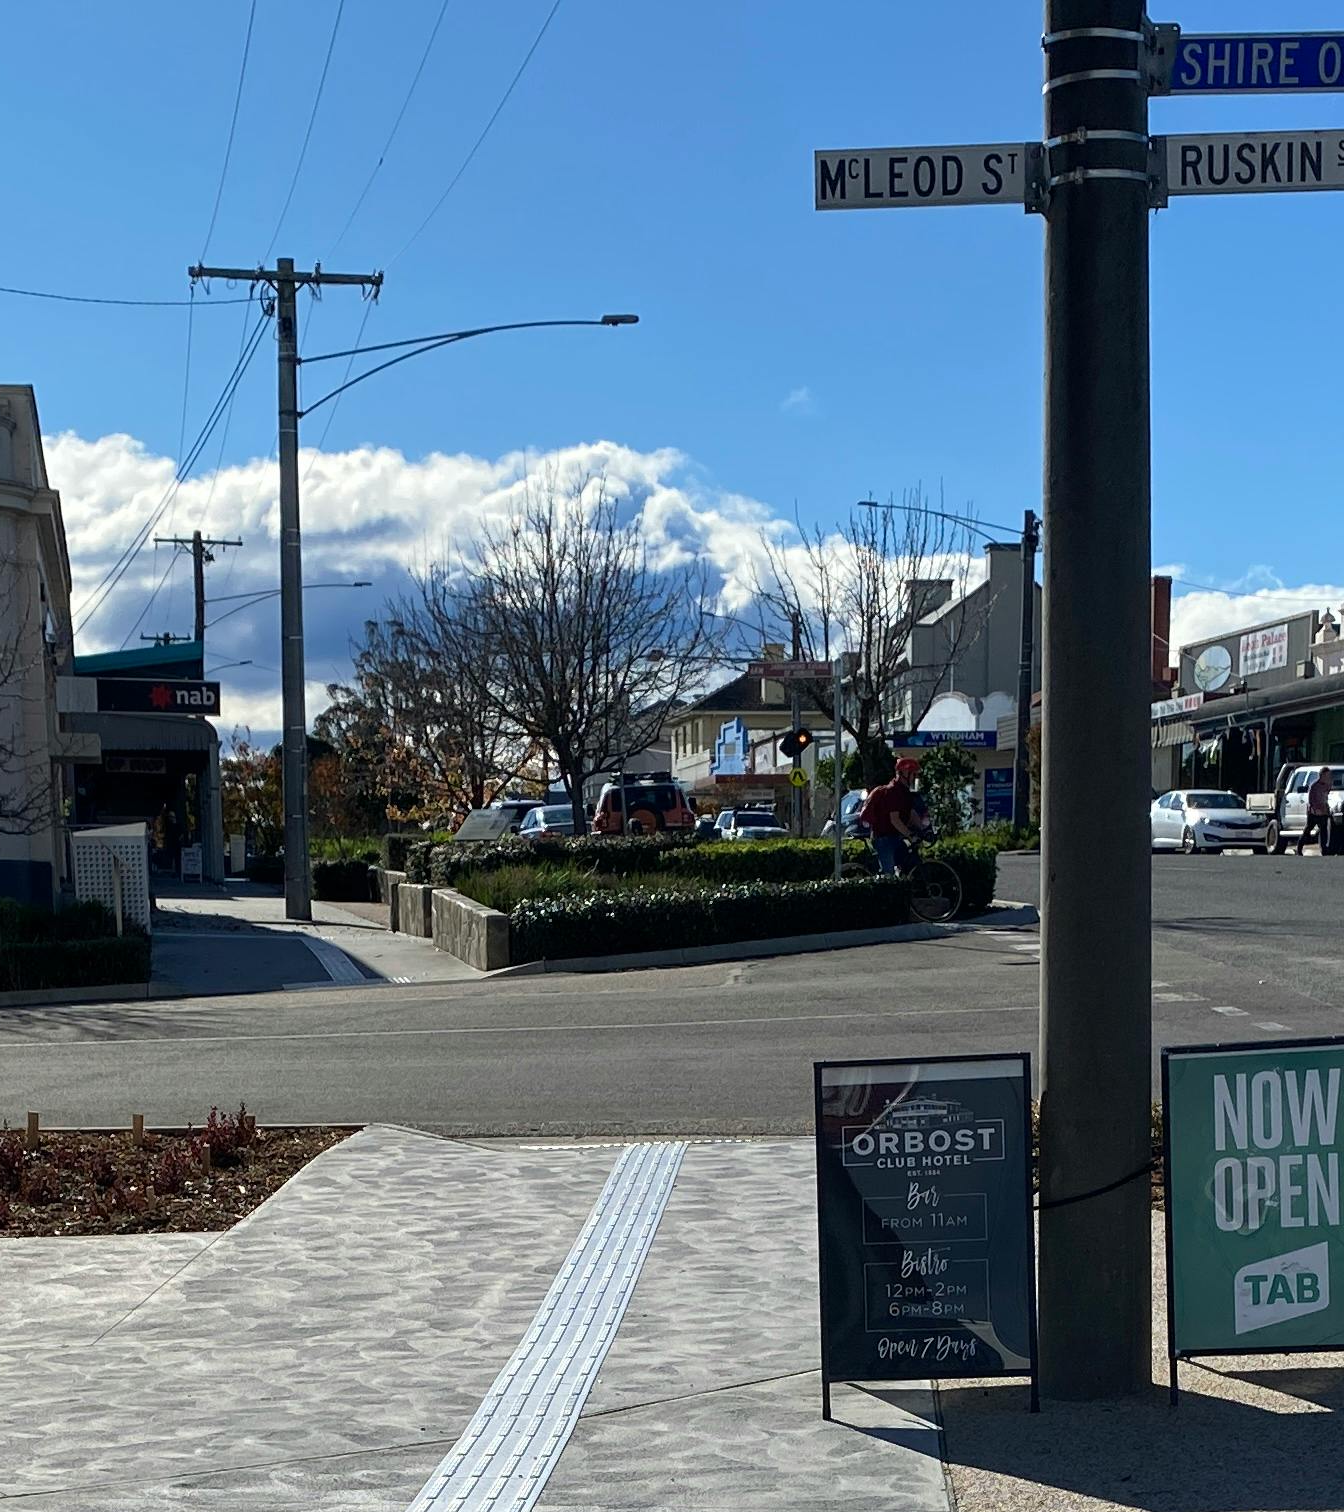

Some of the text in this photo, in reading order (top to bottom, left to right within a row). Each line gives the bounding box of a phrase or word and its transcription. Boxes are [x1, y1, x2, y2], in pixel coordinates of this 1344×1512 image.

[1181, 42, 1301, 86] SHIRE
[1181, 141, 1322, 186] RUSKIN
[176, 686, 216, 706] nab
[930, 732, 985, 741] WYNDHAM
[1214, 1068, 1341, 1150] NOW
[852, 1128, 996, 1156] ORBOST
[876, 1155, 971, 1168] CLUB HOTEL
[907, 1181, 941, 1210] Bar
[1214, 1153, 1341, 1231] OPEN
[881, 1212, 968, 1229] FROM 11AM
[901, 1247, 951, 1278] Bistro
[1244, 1272, 1321, 1306] TAB
[877, 1335, 977, 1361] Open 7 Days
